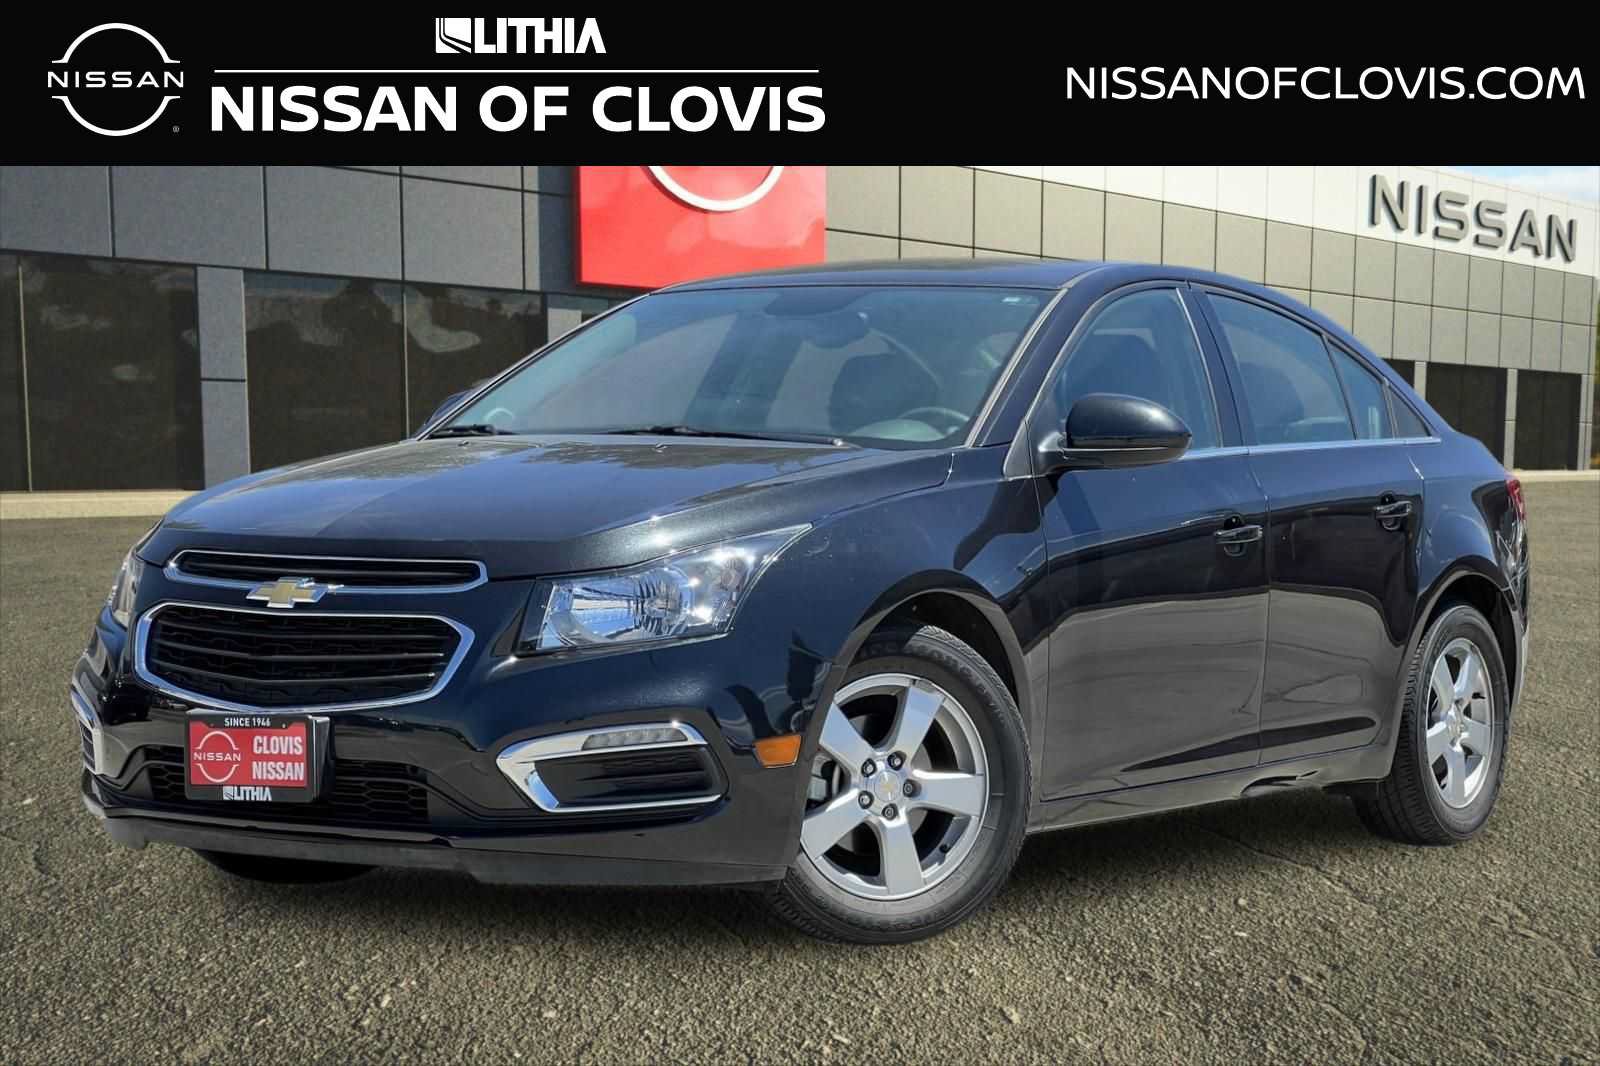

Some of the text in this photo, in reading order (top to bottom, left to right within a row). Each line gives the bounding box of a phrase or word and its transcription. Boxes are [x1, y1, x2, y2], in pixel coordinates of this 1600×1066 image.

[1368, 174, 1577, 263] NISSAN
[224, 717, 271, 727] SINCE 1946
[253, 735, 303, 755] CLOVIS
[193, 751, 241, 761] NISSAN
[252, 761, 304, 781] NISSAN
[233, 786, 272, 801] LITHIA
